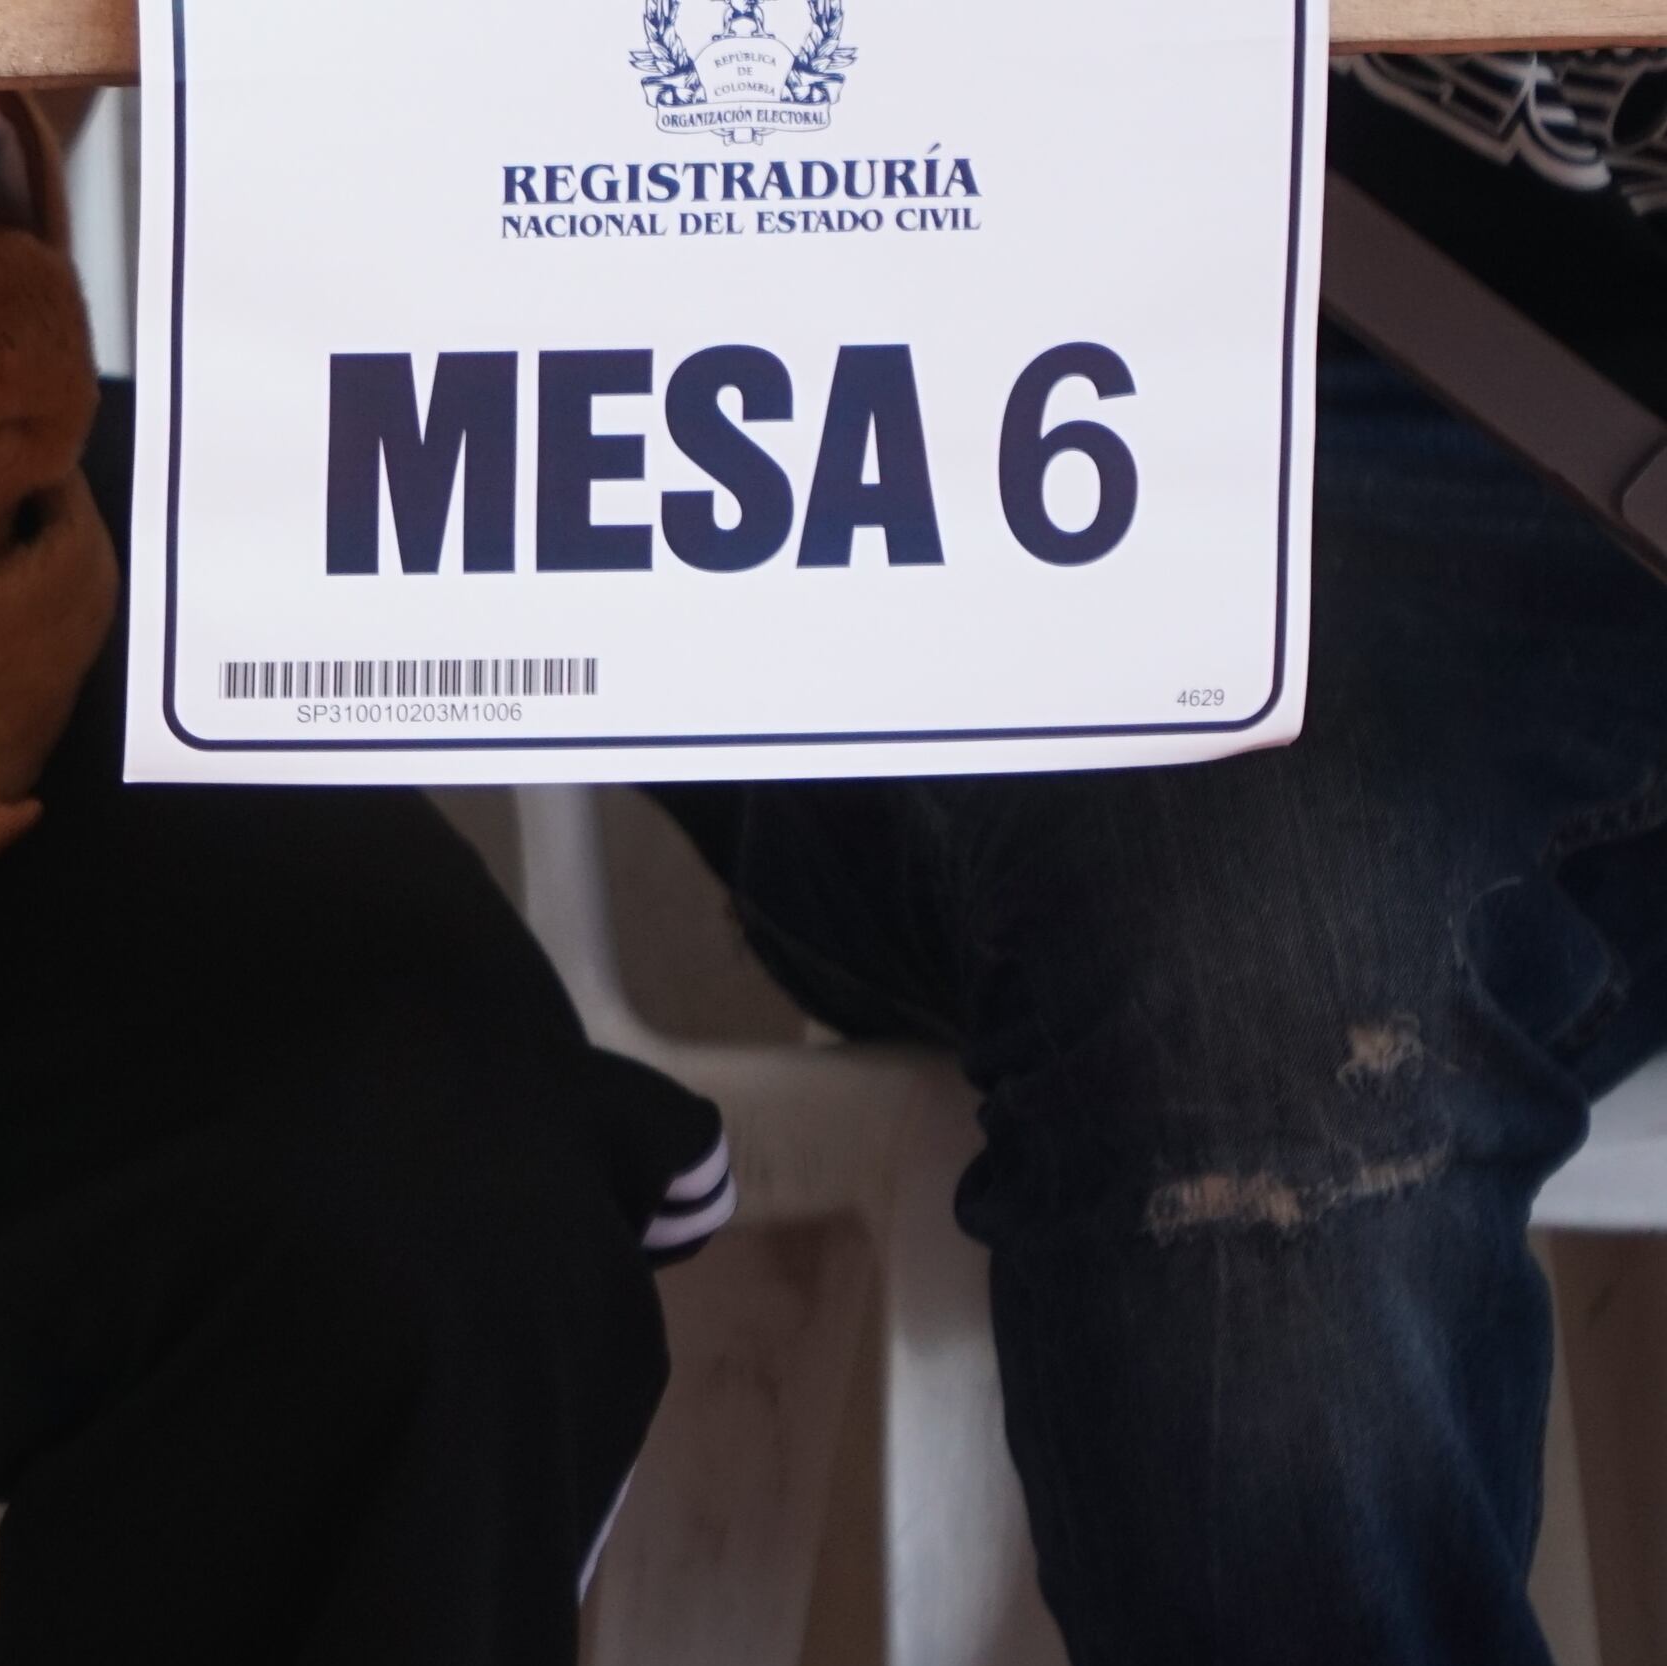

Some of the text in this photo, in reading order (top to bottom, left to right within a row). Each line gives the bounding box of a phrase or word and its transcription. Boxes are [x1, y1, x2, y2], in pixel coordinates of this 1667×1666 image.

[714, 51, 776, 68] REPÚBLICA
[737, 66, 753, 76] DE
[714, 82, 776, 97] COLOMBIA
[662, 106, 827, 127] ORGANIZACIÓN ELECTORAL
[502, 142, 981, 204] REGISTRADURÍA
[501, 202, 981, 239] NACIONAL DEL ESTADO CIVIL
[325, 341, 1139, 575] MESA 6
[1176, 688, 1225, 707] 4629
[297, 702, 523, 723] SP310010203M1006
